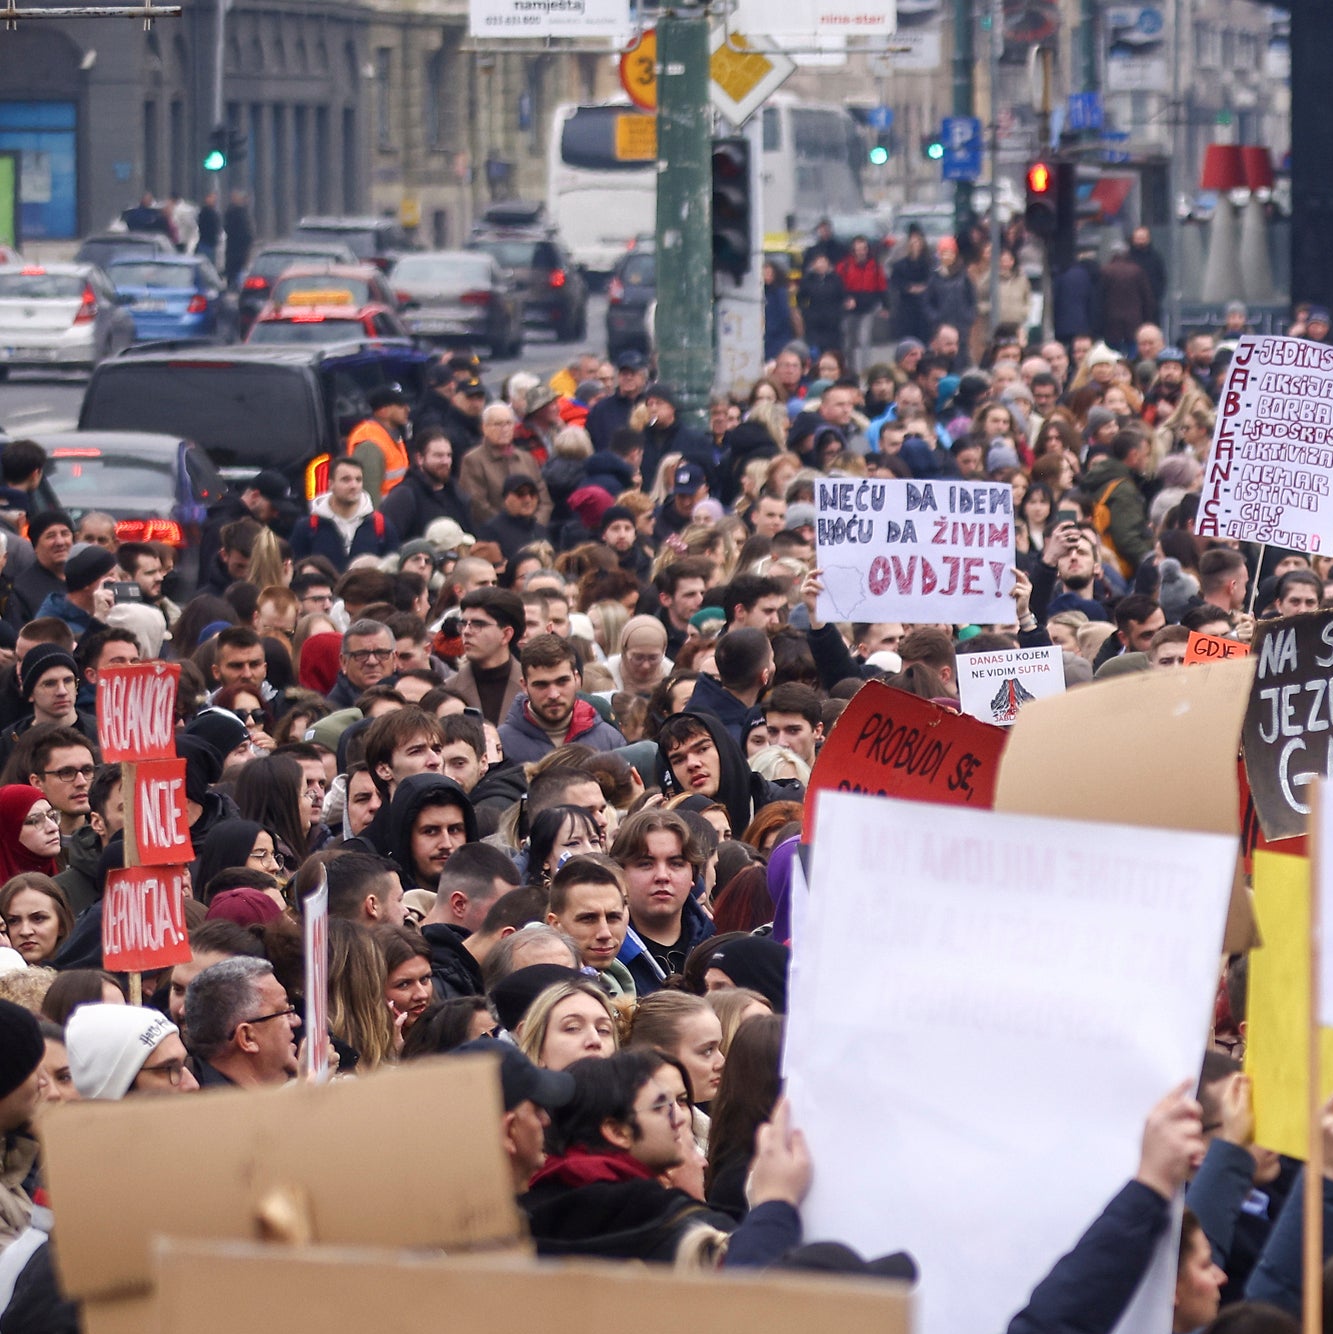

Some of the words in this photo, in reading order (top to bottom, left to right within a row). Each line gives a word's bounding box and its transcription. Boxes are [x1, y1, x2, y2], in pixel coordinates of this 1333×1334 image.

[1256, 395, 1332, 425] BORBA
[1241, 464, 1330, 496] NEMAR
[819, 480, 886, 511] NEĆU
[906, 483, 938, 511] DA
[949, 486, 1011, 514] IDEM
[818, 514, 873, 545] HOĆU
[887, 520, 918, 543] DA
[931, 516, 1010, 547] ŽIVIM
[868, 555, 1006, 598] OVDJE!
[969, 655, 1004, 676] DANAS
[1006, 654, 1013, 662] U
[1016, 650, 1050, 661] KOJEM
[1258, 627, 1297, 679] NA
[972, 669, 985, 679] NE
[987, 667, 1016, 677] VIDIM
[1018, 664, 1050, 674] SUTRA
[853, 713, 952, 784] PROBUDI
[947, 753, 982, 801] SE,
[141, 777, 185, 849] NIJE
